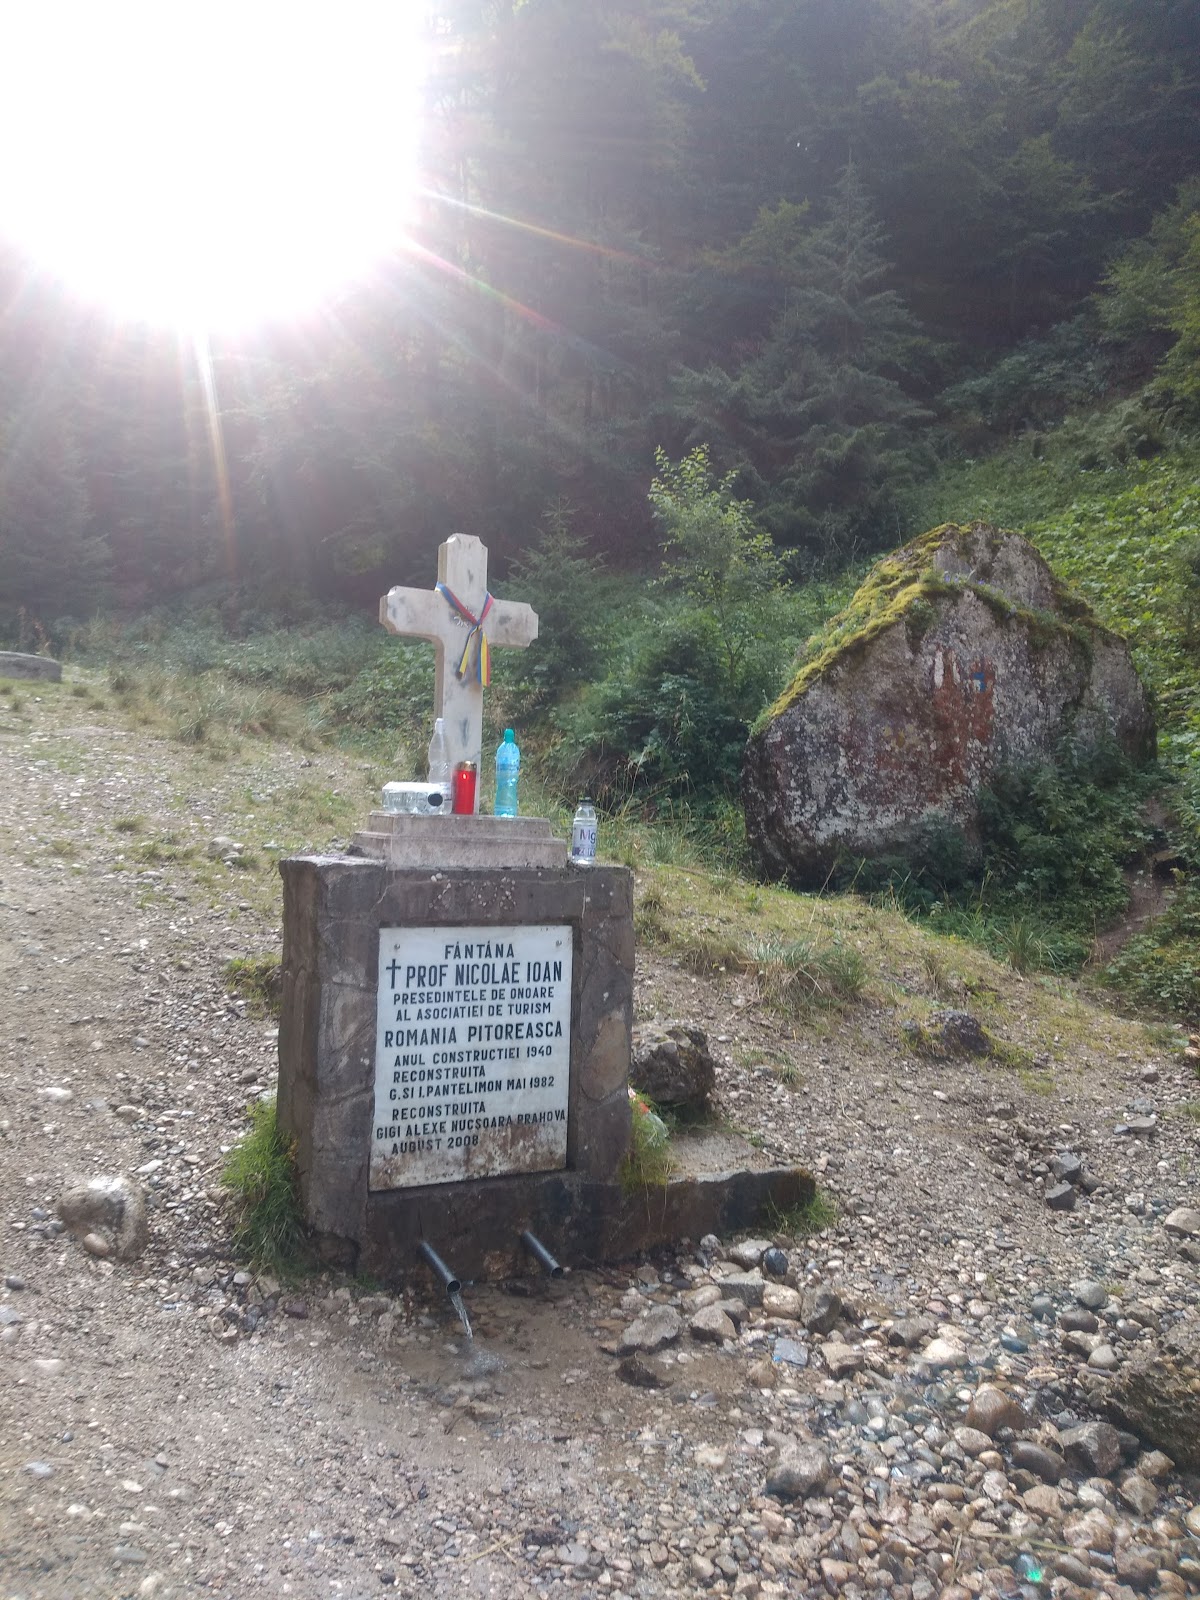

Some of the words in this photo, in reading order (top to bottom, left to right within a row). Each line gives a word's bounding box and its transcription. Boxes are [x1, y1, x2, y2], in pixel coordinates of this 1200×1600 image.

[406, 965, 448, 988] PROF
[455, 962, 520, 986] NICOLAE
[527, 961, 562, 983] IOAN
[393, 989, 486, 1005] PRESEDINTELE
[492, 989, 505, 1000] DE
[510, 987, 554, 999] ONOARE
[396, 1009, 411, 1021] AL
[417, 1006, 483, 1020] ASOCIATIEI
[488, 1005, 502, 1016] DE
[508, 1002, 551, 1015] TURISM
[385, 1027, 457, 1047] ROMANIA
[468, 1021, 562, 1042] PITOREASCA
[394, 1054, 425, 1066] ANUL
[433, 1048, 520, 1064] CONSTRUCTIEI
[527, 1046, 552, 1058] 1940
[393, 1066, 486, 1082] RECONSTRUITA
[507, 1079, 526, 1090] MAI
[529, 1076, 554, 1089] 1982
[392, 1102, 486, 1121] RECONSTRUITA
[377, 1126, 401, 1139] GIGI
[406, 1121, 446, 1137] ALEXE
[517, 1110, 565, 1125] PRAHOVA
[392, 1138, 442, 1155] AUGUST
[448, 1135, 478, 1148] 2008
